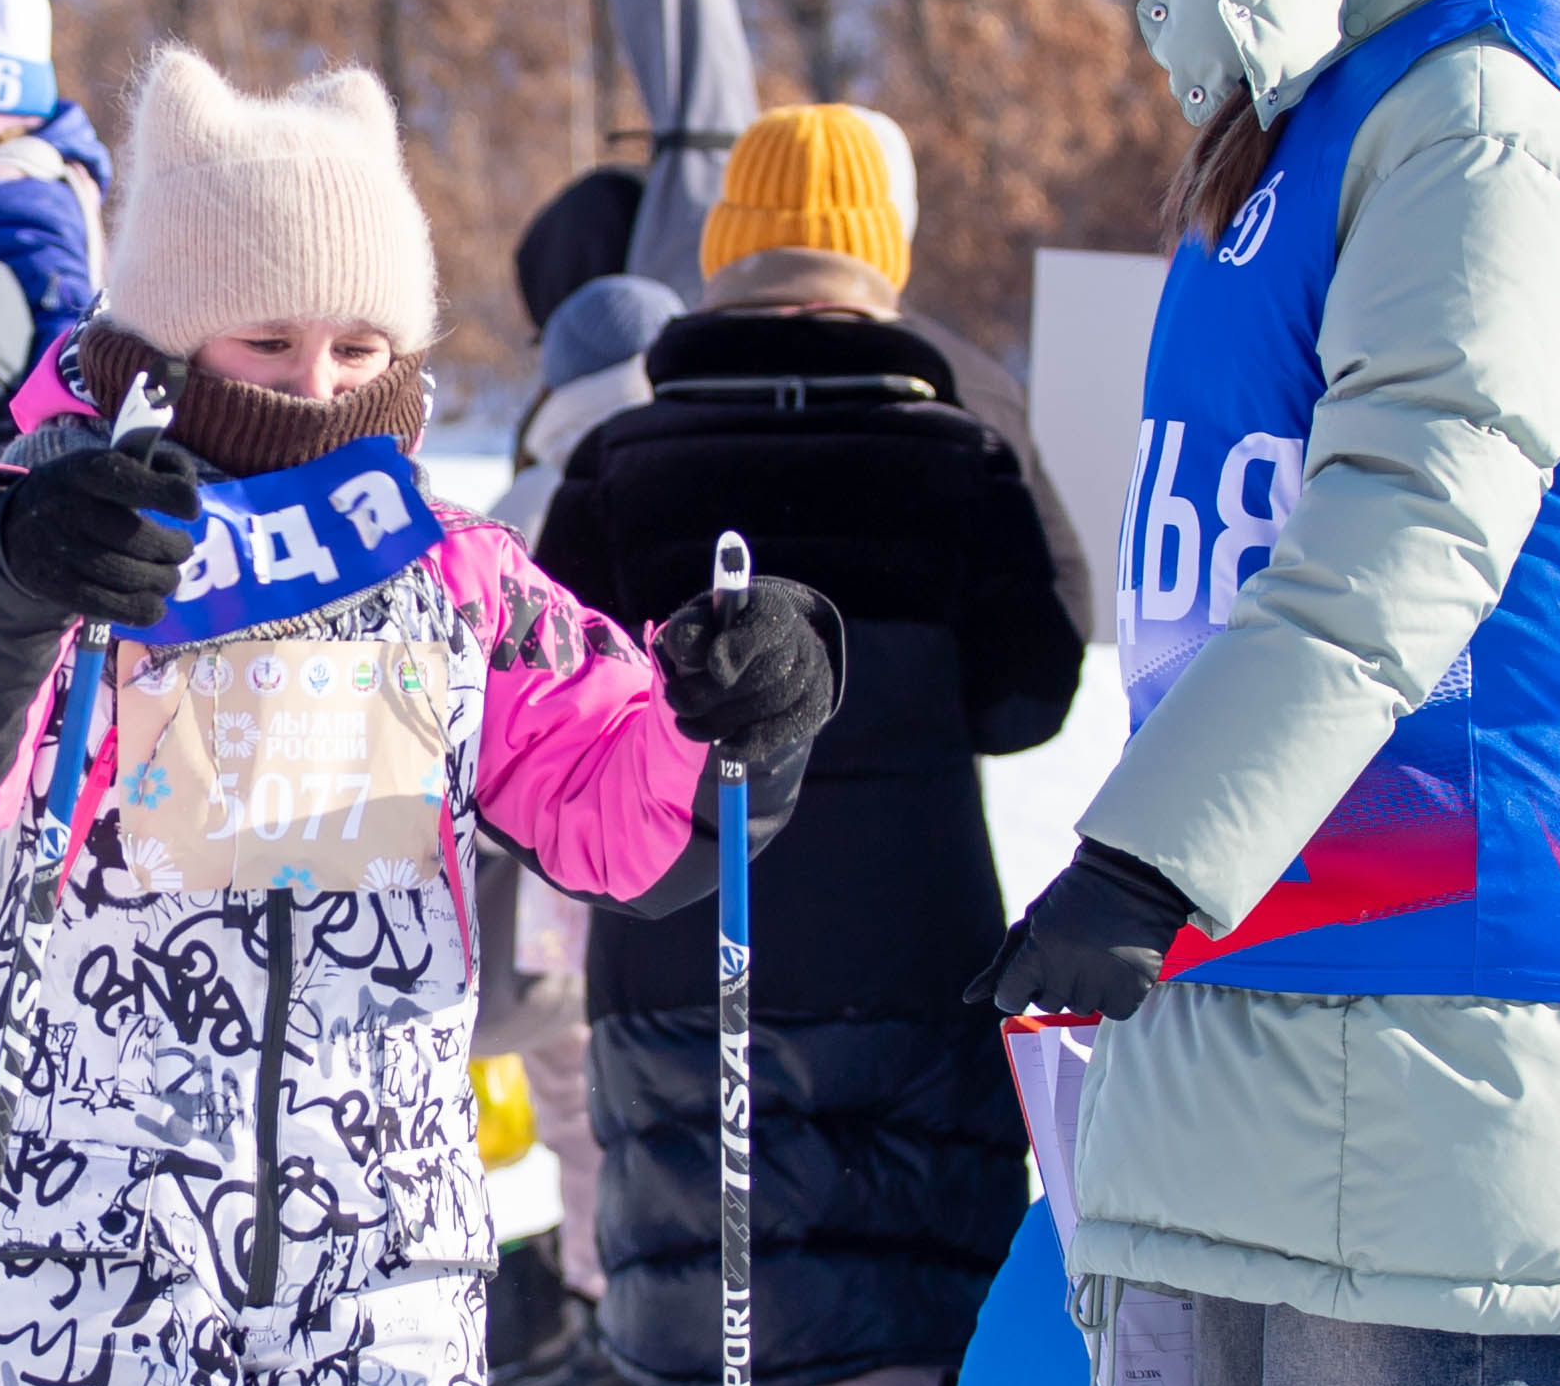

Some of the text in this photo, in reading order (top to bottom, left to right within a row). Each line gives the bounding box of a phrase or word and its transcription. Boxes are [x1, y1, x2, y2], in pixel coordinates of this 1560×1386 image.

[87, 621, 113, 645] 125
[266, 711, 367, 738] ЛЫЖНЯ
[264, 738, 369, 760] РОССИИ
[720, 758, 744, 778] 125
[206, 772, 372, 842] 5077
[721, 1029, 751, 1192] TISA
